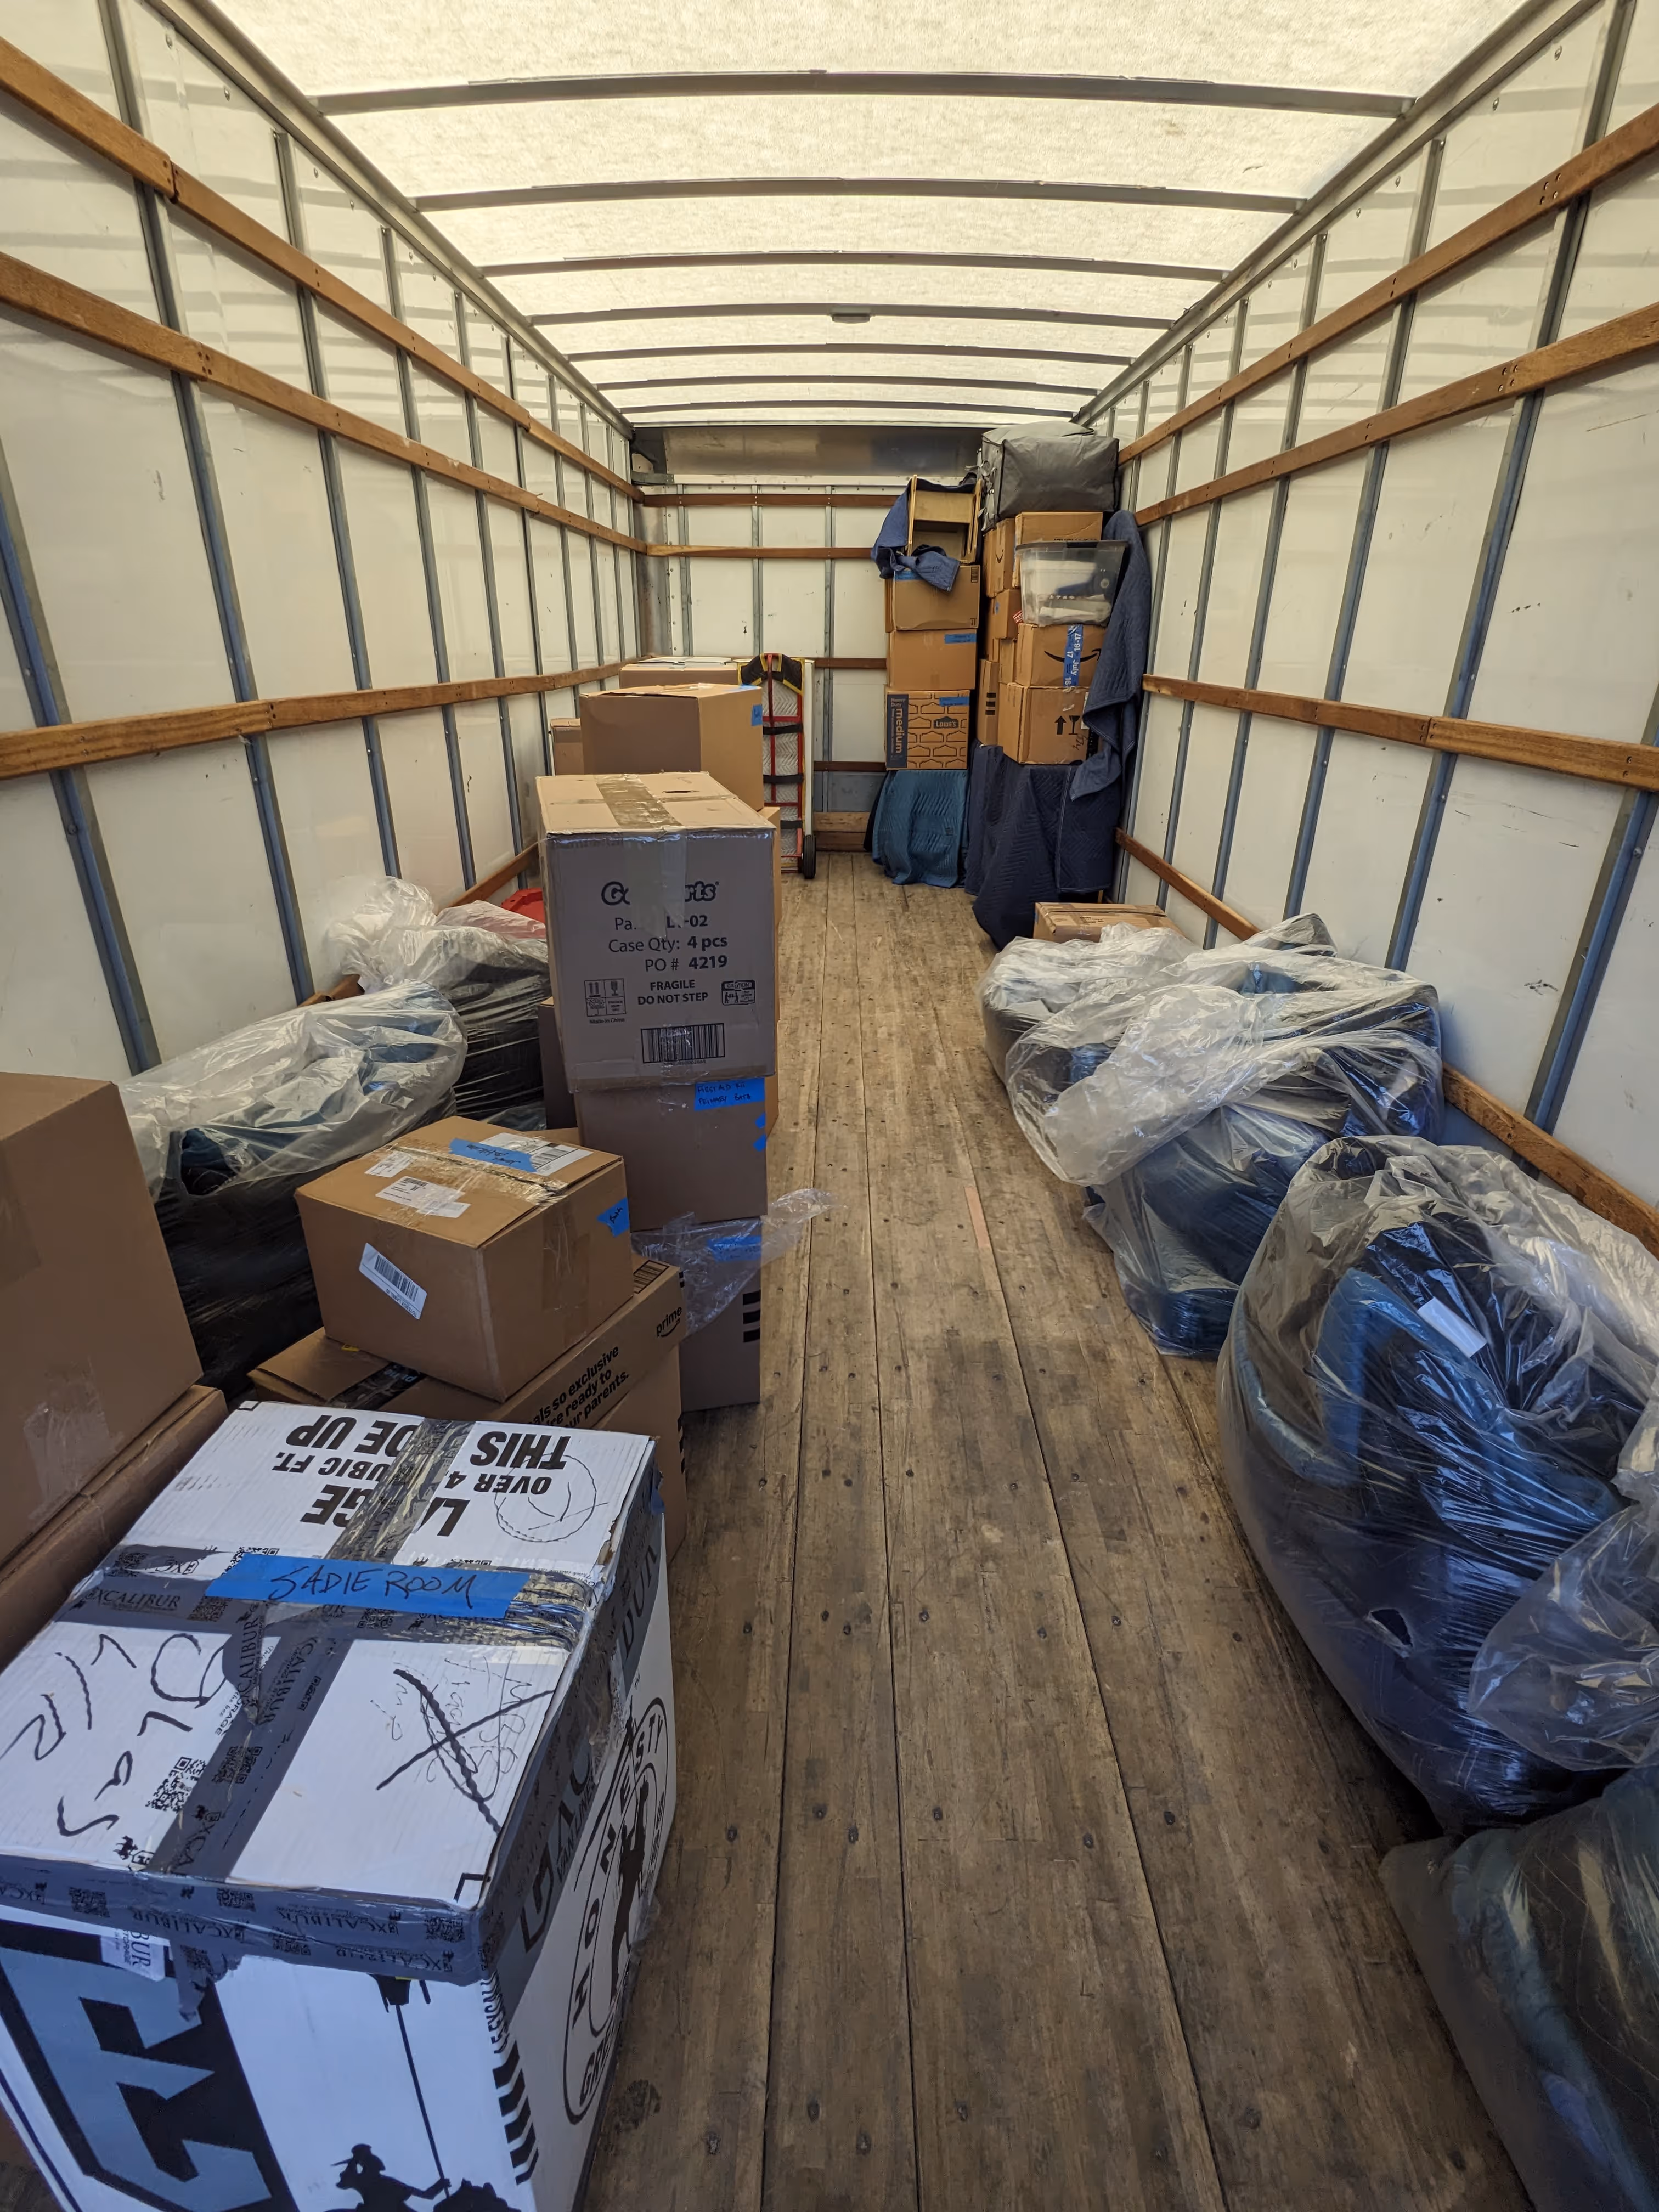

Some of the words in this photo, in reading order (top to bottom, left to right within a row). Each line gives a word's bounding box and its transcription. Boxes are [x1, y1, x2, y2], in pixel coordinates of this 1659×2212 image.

[1070, 659, 1079, 676] July
[895, 708, 905, 754] medium
[667, 915, 708, 928] L-02
[608, 939, 644, 952] Case
[648, 937, 680, 953] Qty:
[687, 936, 698, 949] 4
[702, 936, 728, 951] pcs
[645, 958, 667, 972] PO
[671, 958, 679, 970] #
[689, 955, 728, 969] 4219
[637, 996, 654, 1005] DO
[658, 994, 680, 1003] NOT
[682, 992, 708, 1002] STEP
[650, 979, 696, 991] FRAGILE
[656, 1306, 682, 1338] prime
[552, 1392, 567, 1410] so
[568, 1346, 619, 1396] exclusive
[565, 1381, 598, 1414] ready
[599, 1369, 612, 1385] to
[584, 1372, 630, 1420] parents.
[286, 1414, 357, 1450] UP
[354, 1420, 420, 1458] DE
[272, 1452, 317, 1473] FT.
[470, 1431, 571, 1470] THIS
[318, 1457, 391, 1481] UBIC
[473, 1476, 552, 1494] OVER
[300, 1484, 471, 1537] LAGE
[268, 1565, 377, 1601] SADIE
[385, 1571, 478, 1609] ROOM
[572, 1713, 663, 2029] HONESTY
